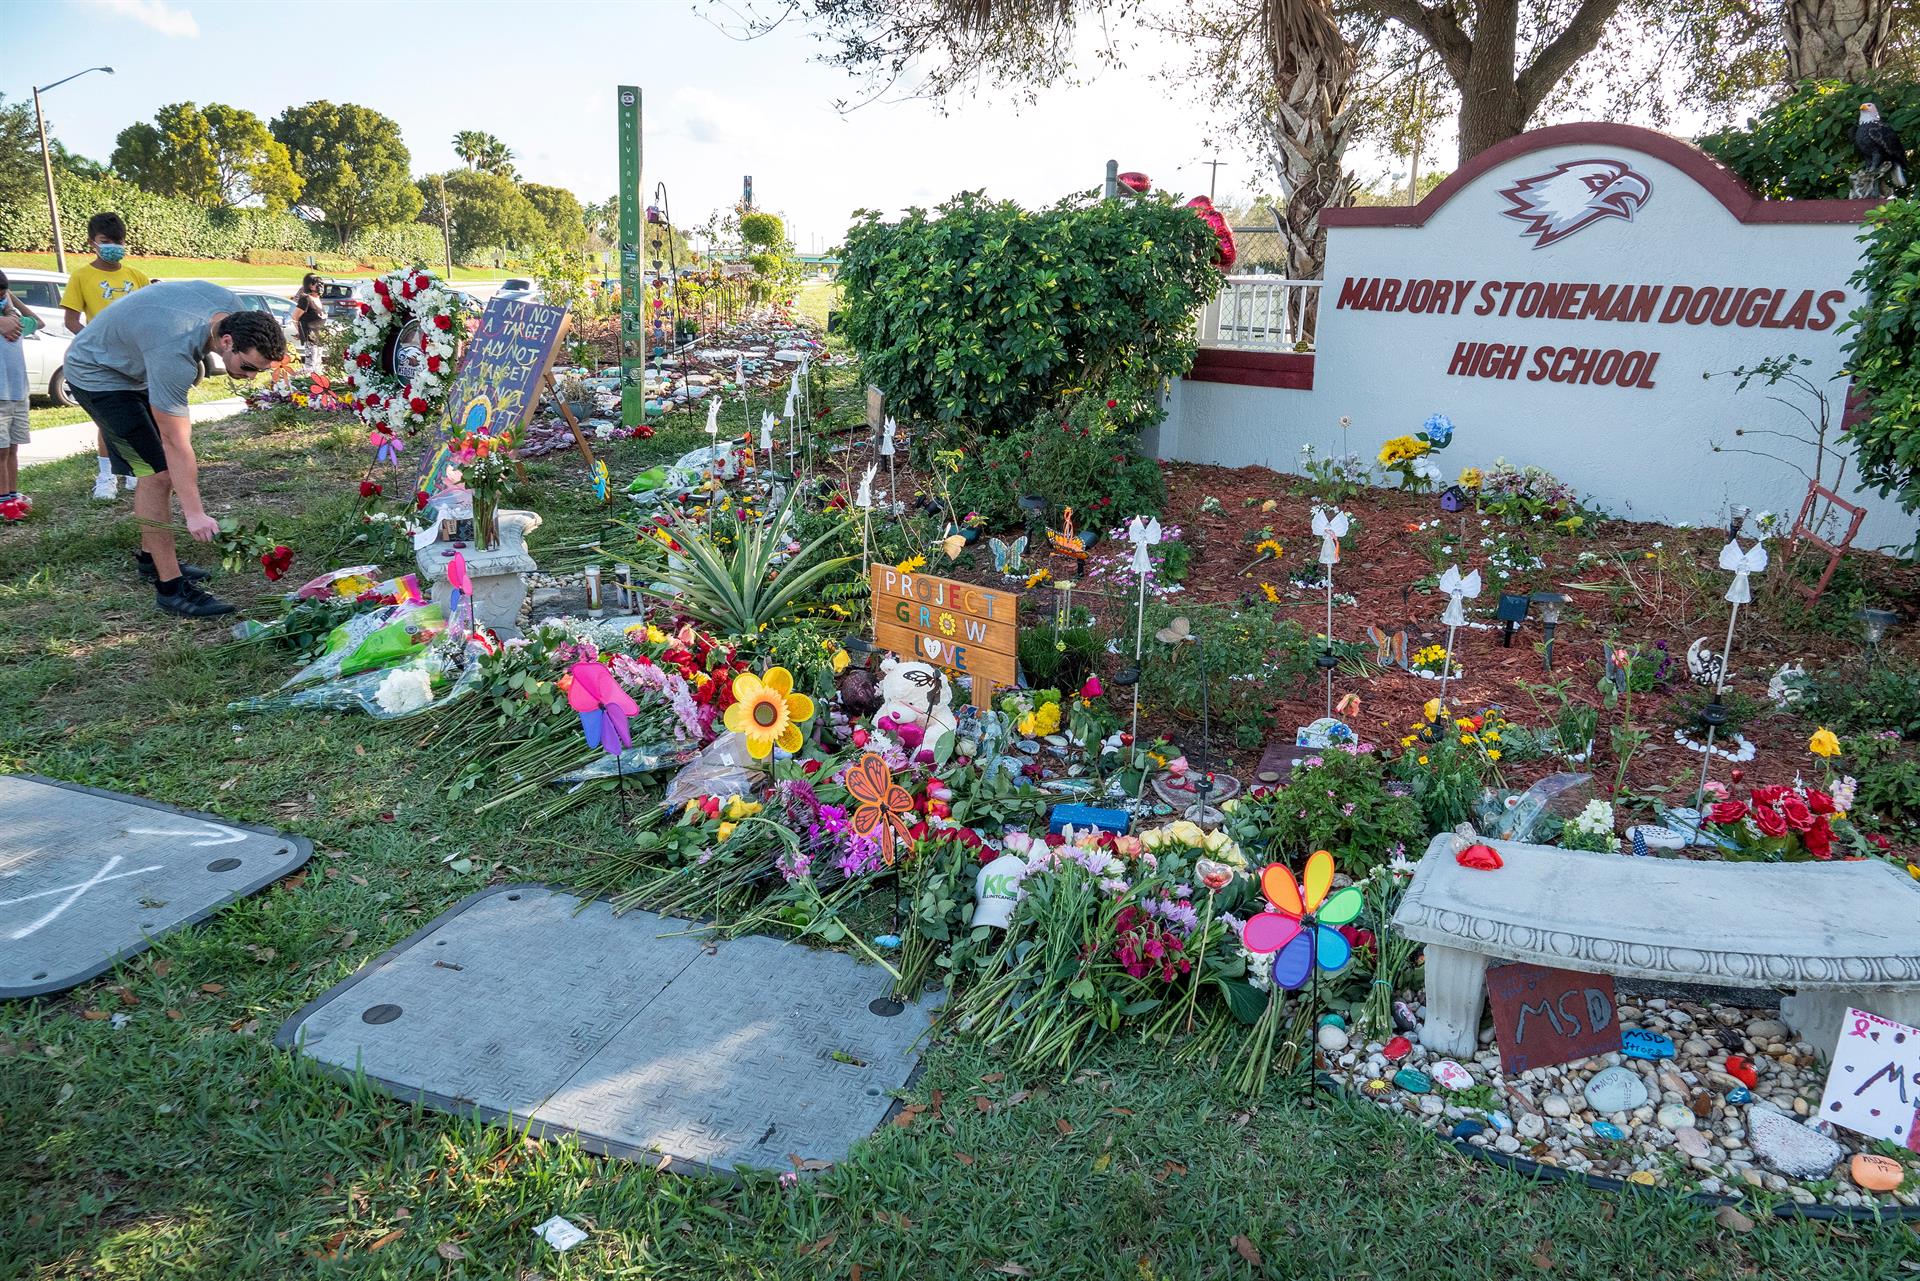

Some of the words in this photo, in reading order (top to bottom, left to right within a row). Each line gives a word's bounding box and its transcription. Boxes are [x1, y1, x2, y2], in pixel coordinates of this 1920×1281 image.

[487, 299, 500, 313] I
[503, 303, 526, 321] AM
[530, 307, 562, 324] NOT
[1336, 276, 1476, 316] MARJORY
[1475, 280, 1664, 323] STONEMAN
[1659, 285, 1846, 331] DOUGLAS
[484, 317, 493, 333] A
[472, 338, 483, 353] I
[482, 339, 504, 358] AM
[506, 343, 541, 366] NOT
[1447, 342, 1528, 381] HIGH
[1526, 345, 1661, 390] SCHOOL
[885, 570, 999, 619] PROJECT
[895, 601, 987, 644] GROW
[914, 634, 967, 671] LOVE
[1515, 988, 1613, 1046] MSD
[1625, 1031, 1665, 1044] MSD
